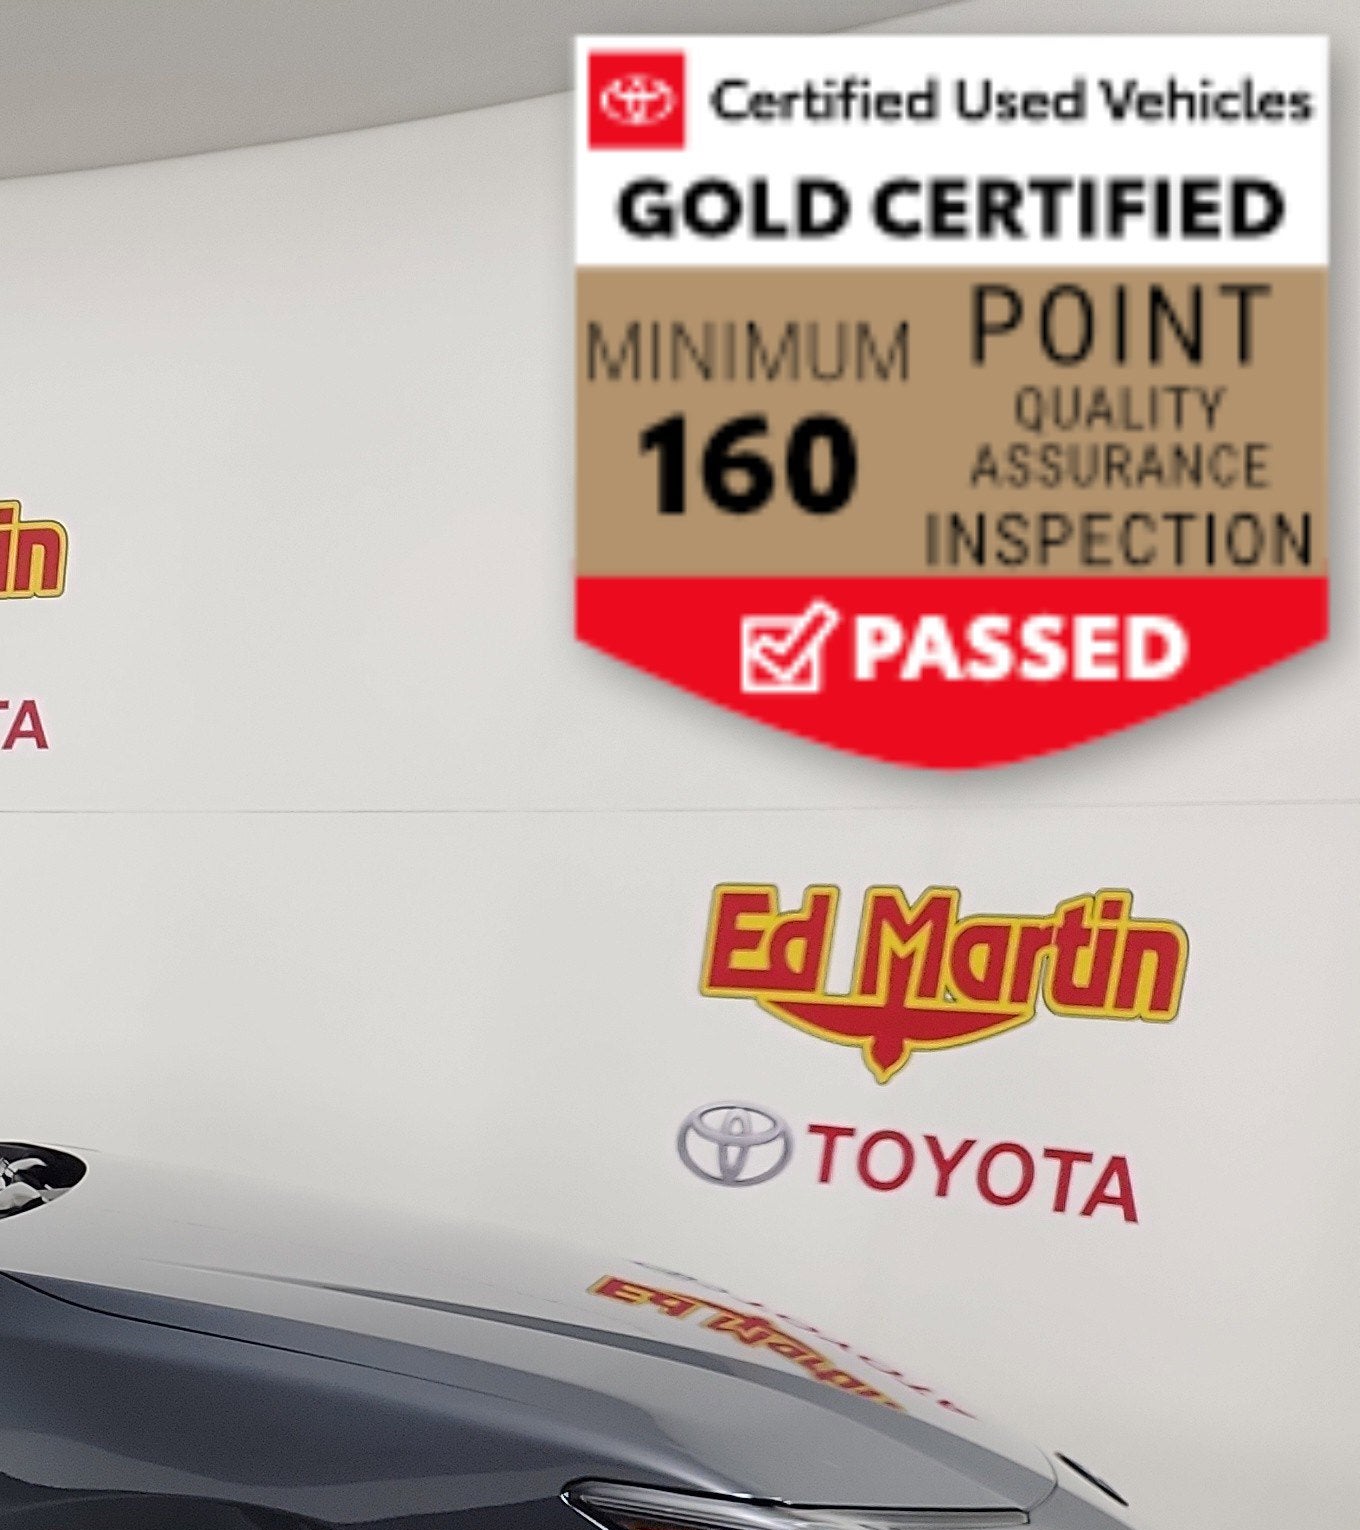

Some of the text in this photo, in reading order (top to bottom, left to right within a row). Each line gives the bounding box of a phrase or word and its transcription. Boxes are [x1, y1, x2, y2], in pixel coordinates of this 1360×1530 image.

[700, 884, 1189, 1023] Ed Martin
[808, 1123, 1139, 1225] TOYOTA
